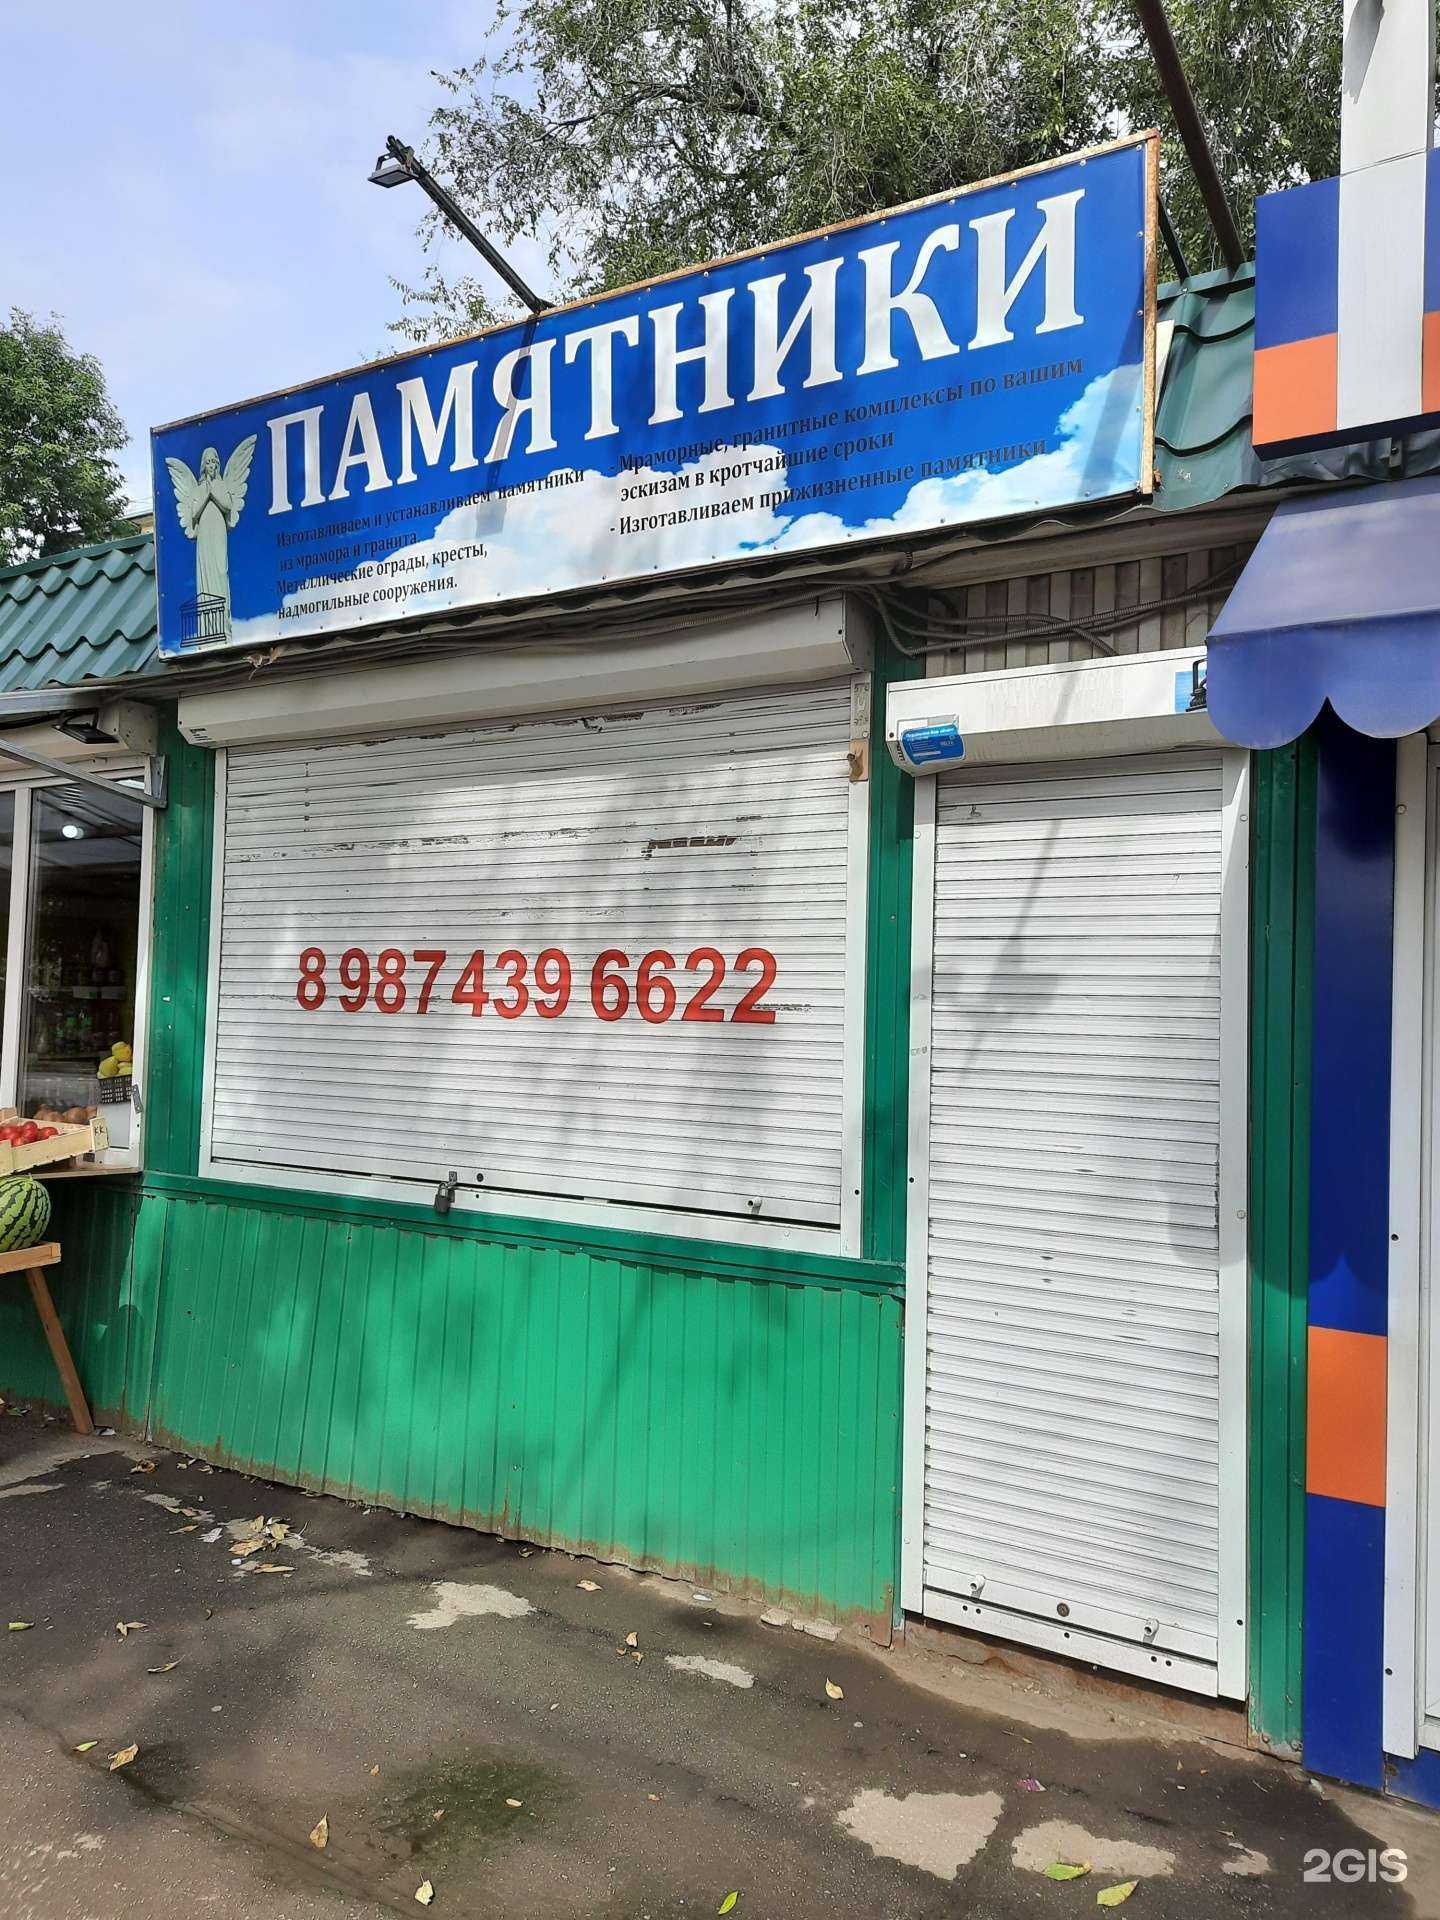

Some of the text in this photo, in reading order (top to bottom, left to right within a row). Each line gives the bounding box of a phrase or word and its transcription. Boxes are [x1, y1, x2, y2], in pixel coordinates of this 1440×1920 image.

[267, 188, 1086, 515] ПАМЯТНИКИ
[619, 437, 728, 474] Мраморные,
[733, 411, 838, 451] гранитные
[844, 384, 963, 424] комплексы
[970, 377, 996, 397] по
[1003, 359, 1083, 389] вашим
[619, 497, 754, 535] Изготавливаем
[760, 464, 914, 511] прижизненные
[921, 439, 1047, 477] памятники
[620, 431, 894, 502] эскизам в кротчайшие сроки
[277, 469, 585, 548] Изготавливаем и устанавливаем памятники
[276, 543, 488, 595] Металлические ограды, кресты,
[279, 559, 294, 572] из
[296, 547, 350, 571] мрамора
[352, 544, 361, 557] и
[277, 576, 458, 620] надмогильные сооружения.
